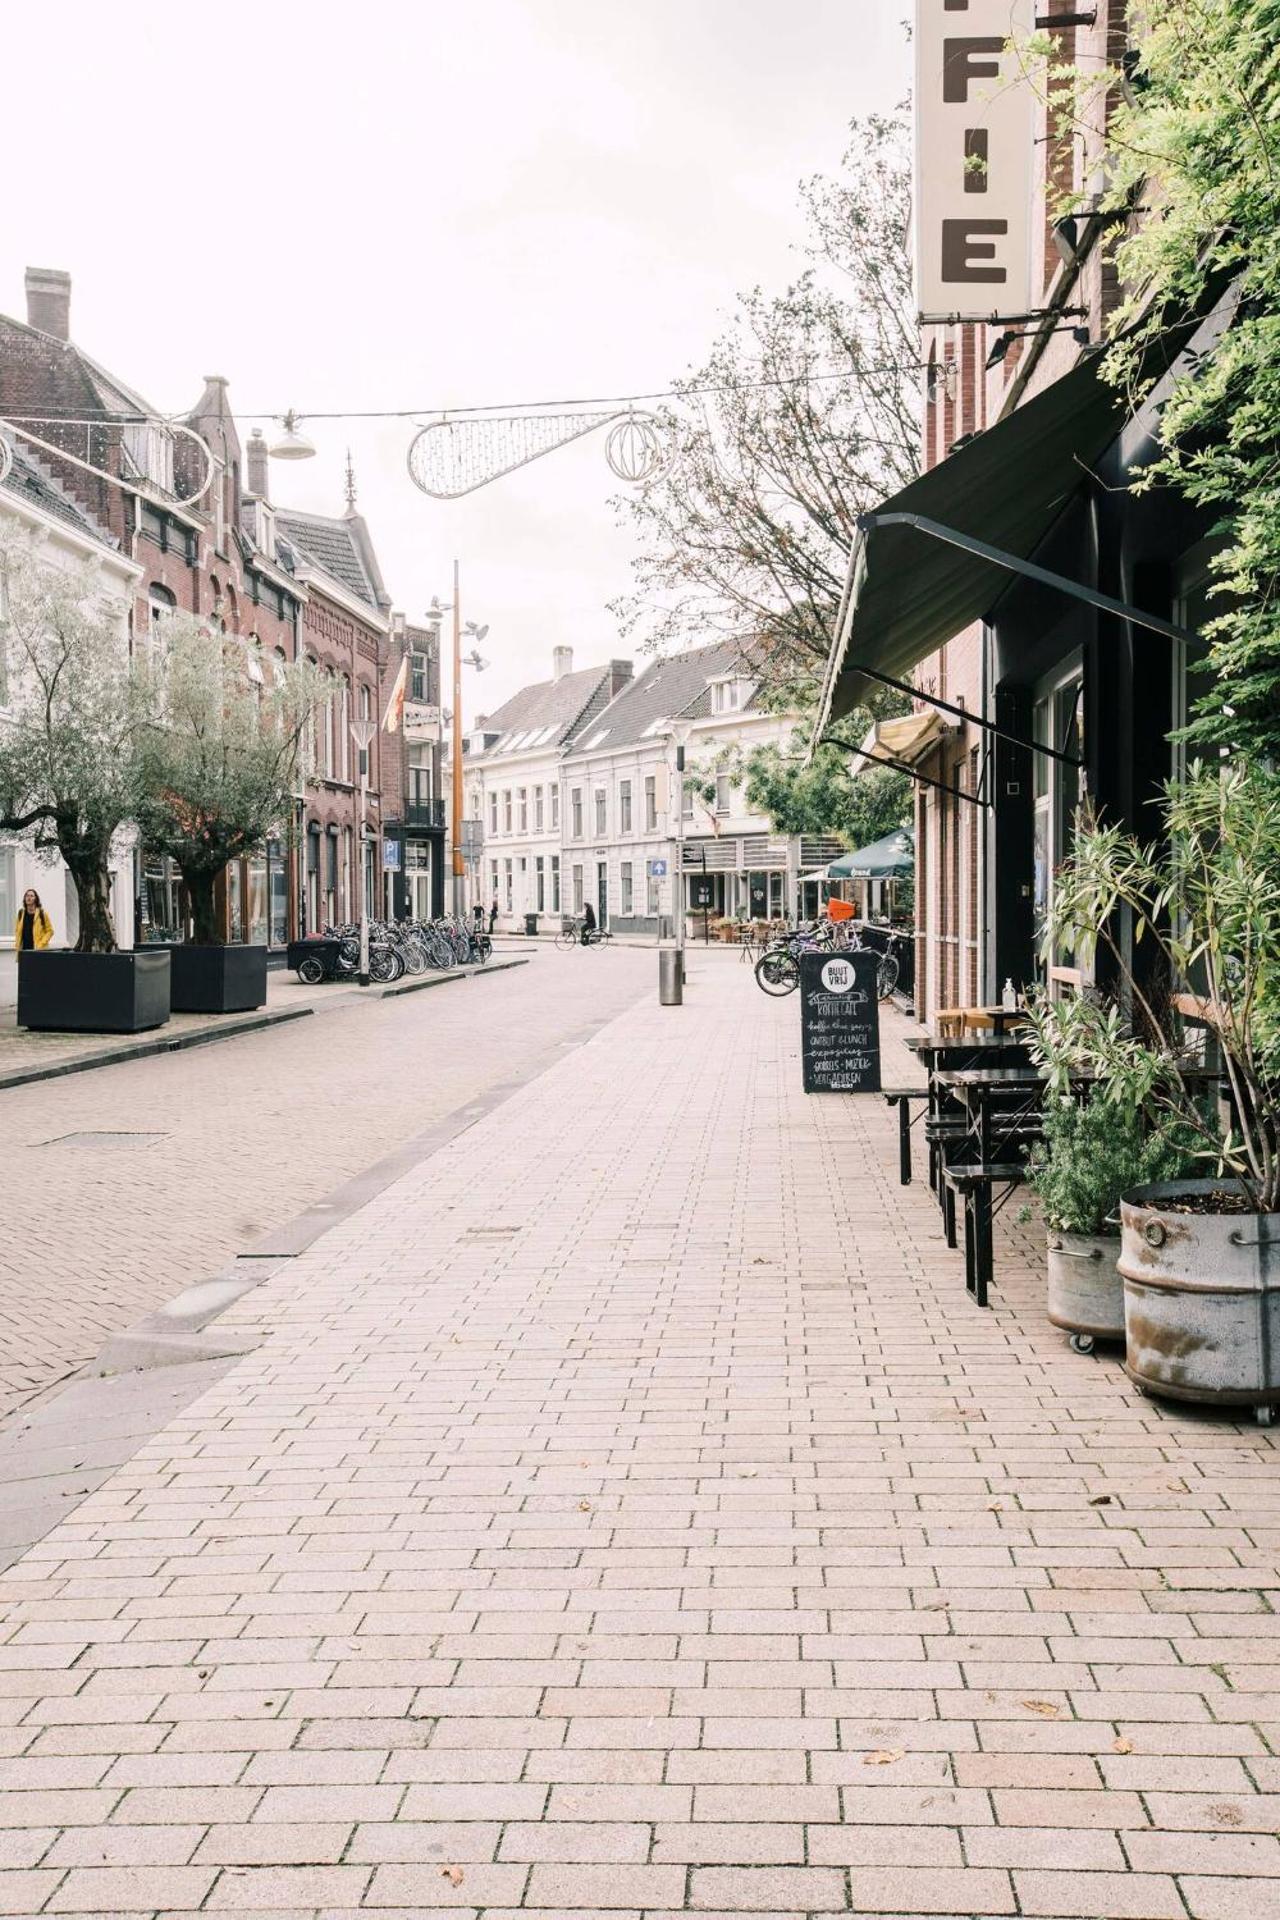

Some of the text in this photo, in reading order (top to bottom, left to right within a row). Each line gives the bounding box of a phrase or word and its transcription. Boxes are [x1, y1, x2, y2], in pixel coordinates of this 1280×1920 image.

[942, 0, 1008, 283] FIE
[387, 843, 394, 854] P
[828, 966, 848, 976] BUUT
[829, 976, 848, 985] VRIJ
